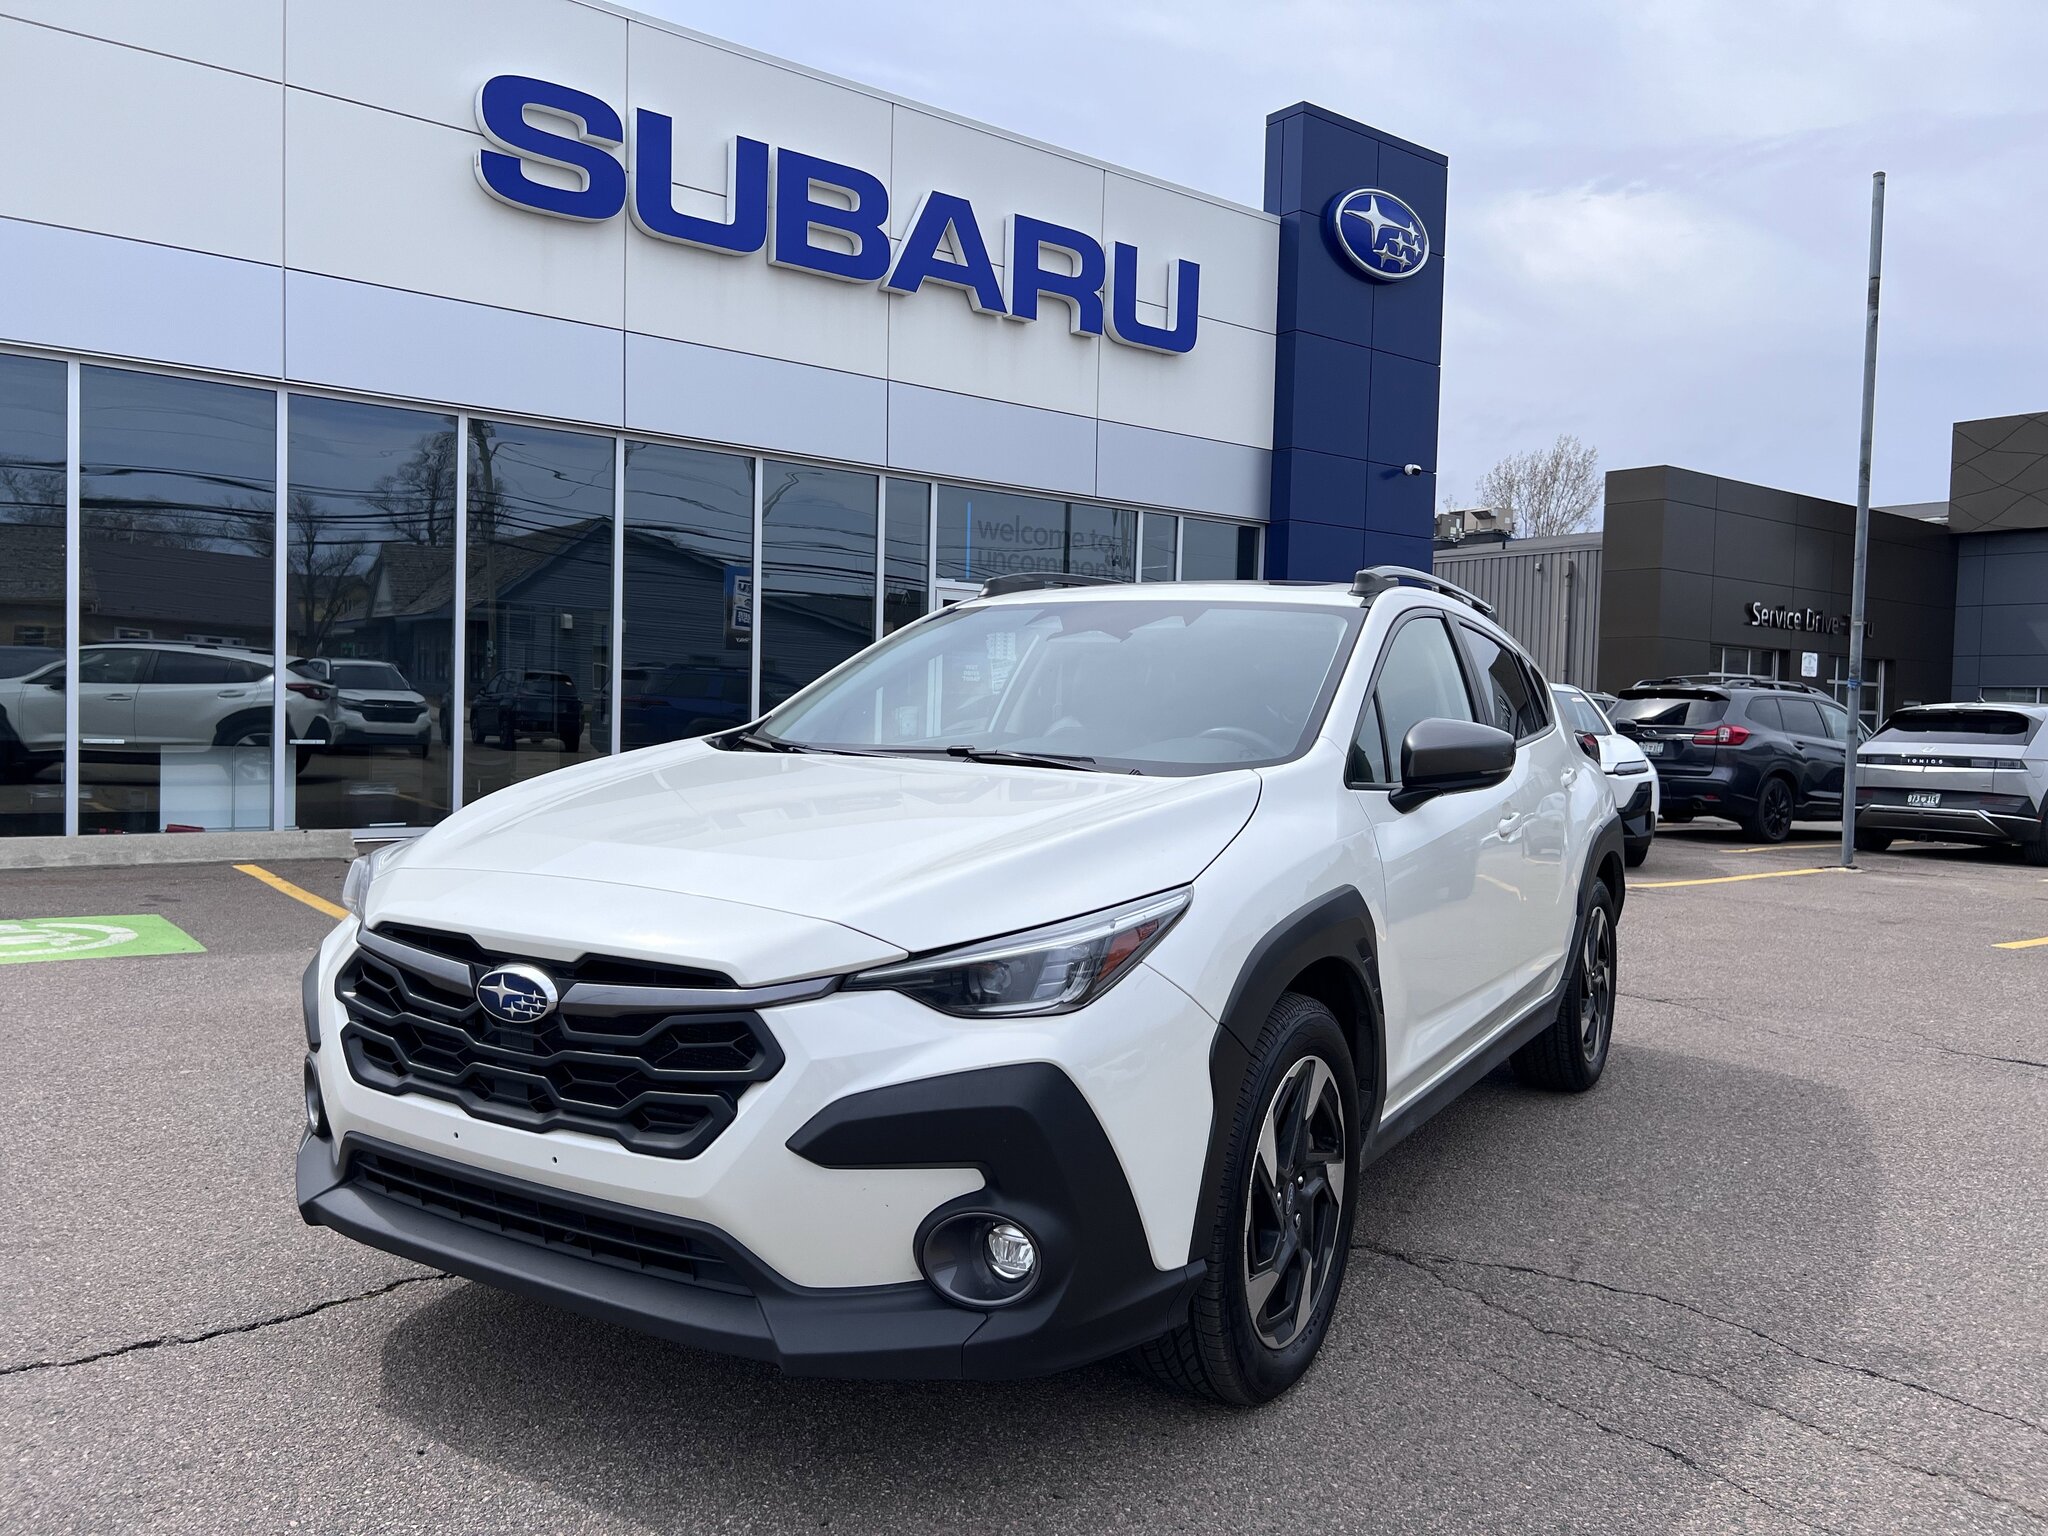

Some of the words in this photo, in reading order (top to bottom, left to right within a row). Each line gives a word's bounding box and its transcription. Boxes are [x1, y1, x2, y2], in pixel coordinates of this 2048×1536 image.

[474, 74, 1200, 355] SUBARU
[977, 514, 1085, 548] welcome
[1752, 602, 1801, 631] Service
